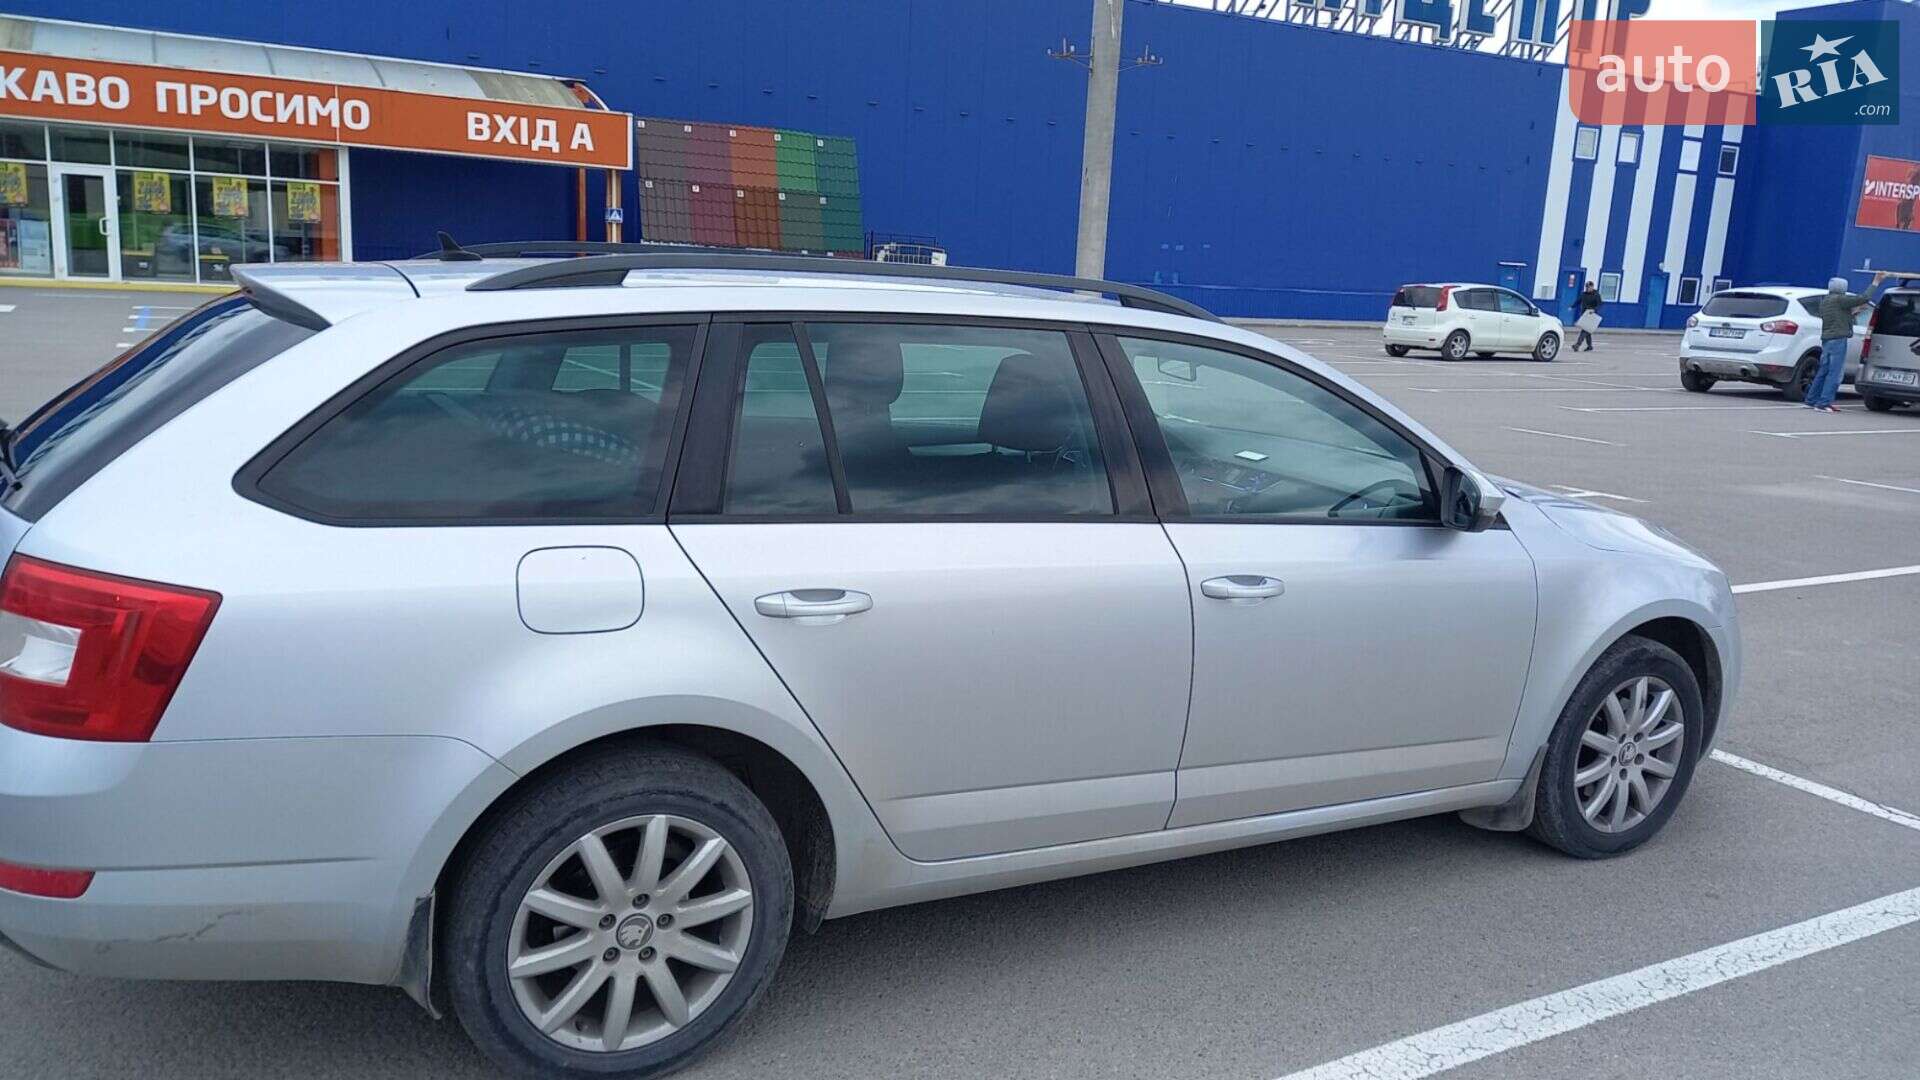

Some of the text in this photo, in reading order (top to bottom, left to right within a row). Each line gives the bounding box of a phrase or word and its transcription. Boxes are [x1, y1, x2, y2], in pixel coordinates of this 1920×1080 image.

[155, 81, 370, 131] ПРОСИМО
[466, 111, 594, 153] ВХІД А
